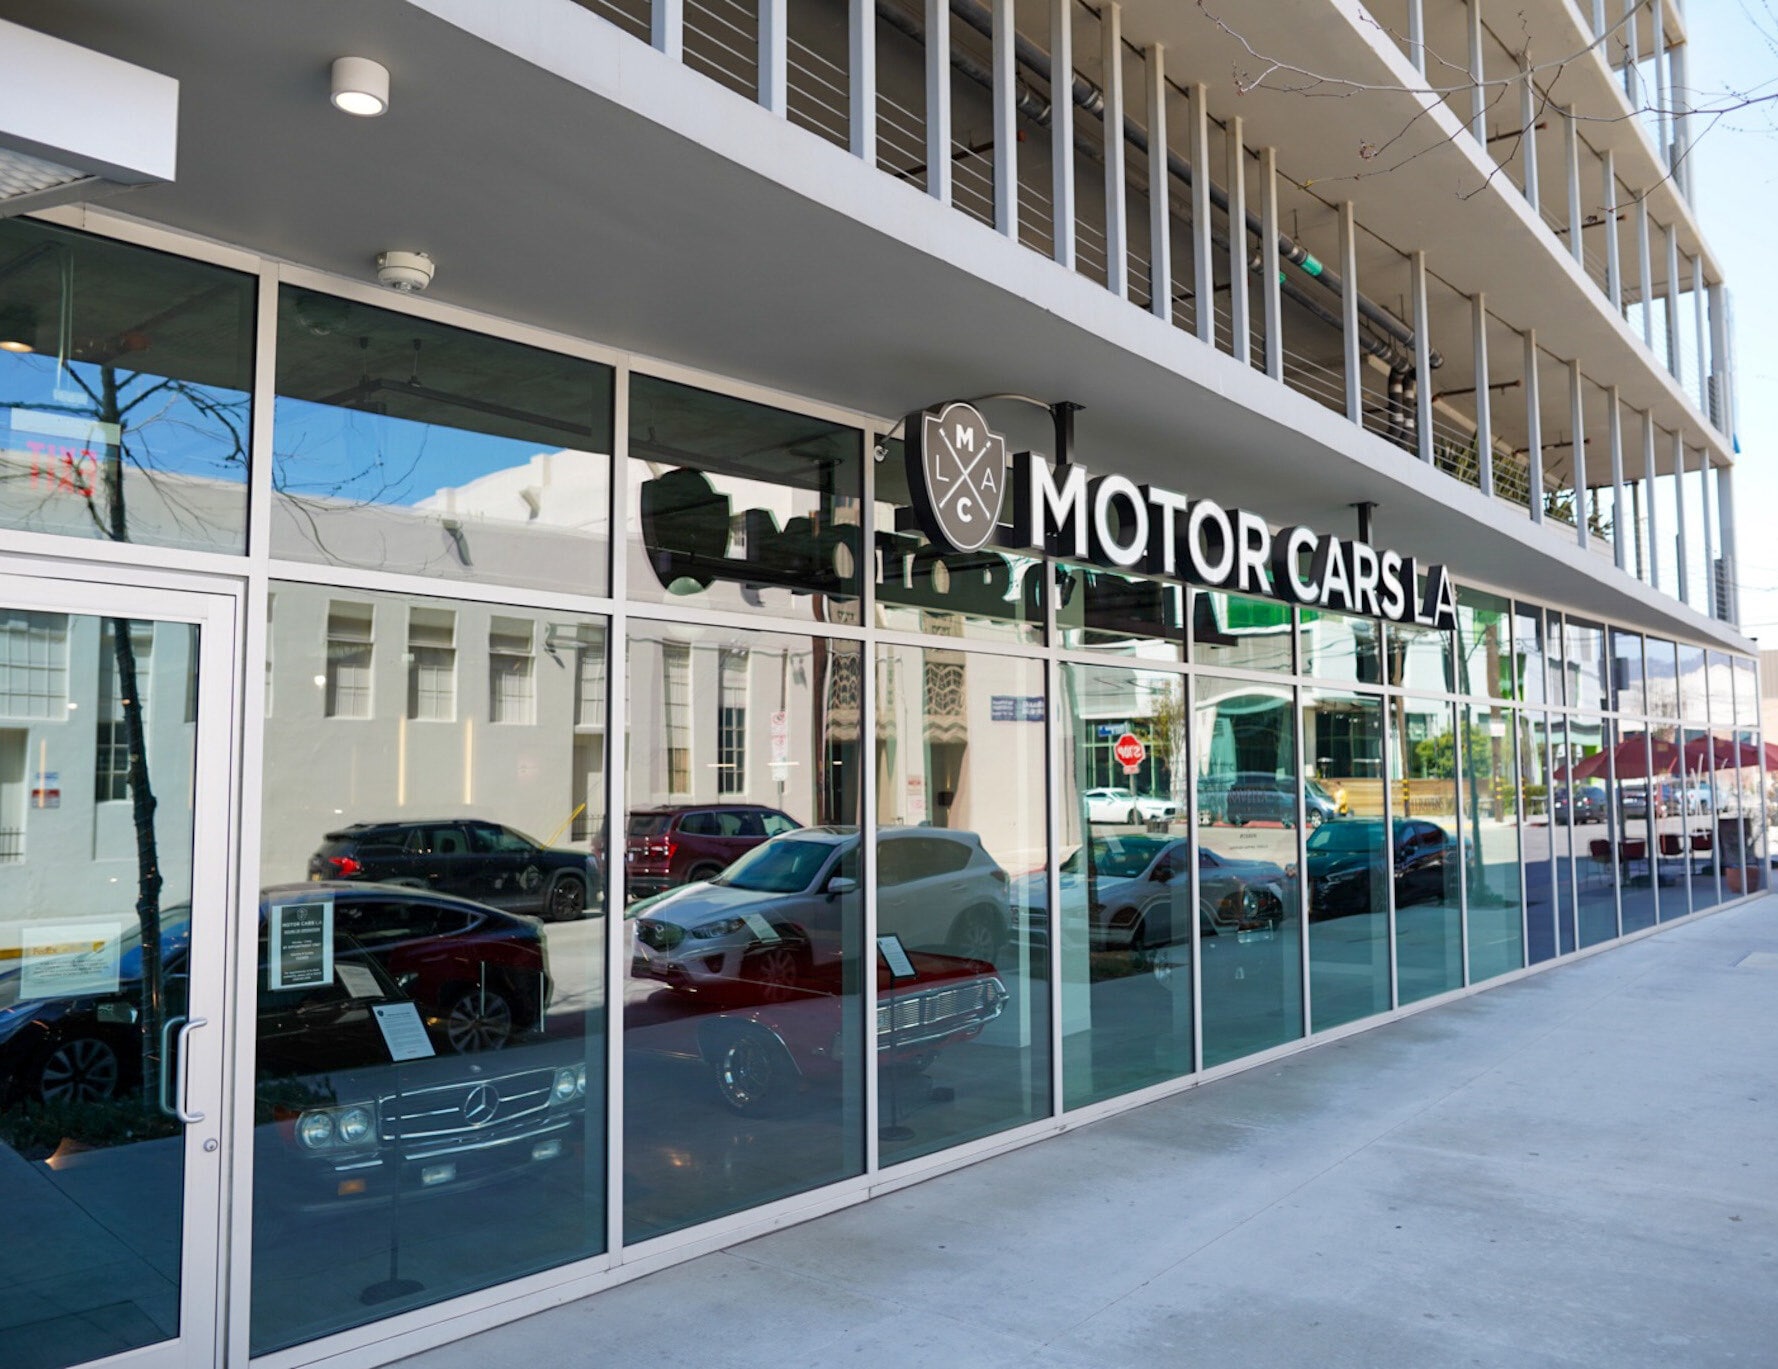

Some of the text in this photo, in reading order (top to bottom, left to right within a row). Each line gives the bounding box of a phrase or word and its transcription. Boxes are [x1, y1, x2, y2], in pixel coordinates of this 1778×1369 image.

[955, 423, 974, 452] M
[935, 454, 997, 494] L A
[956, 496, 973, 523] C
[1030, 451, 1458, 630] MOTOR CARS LA
